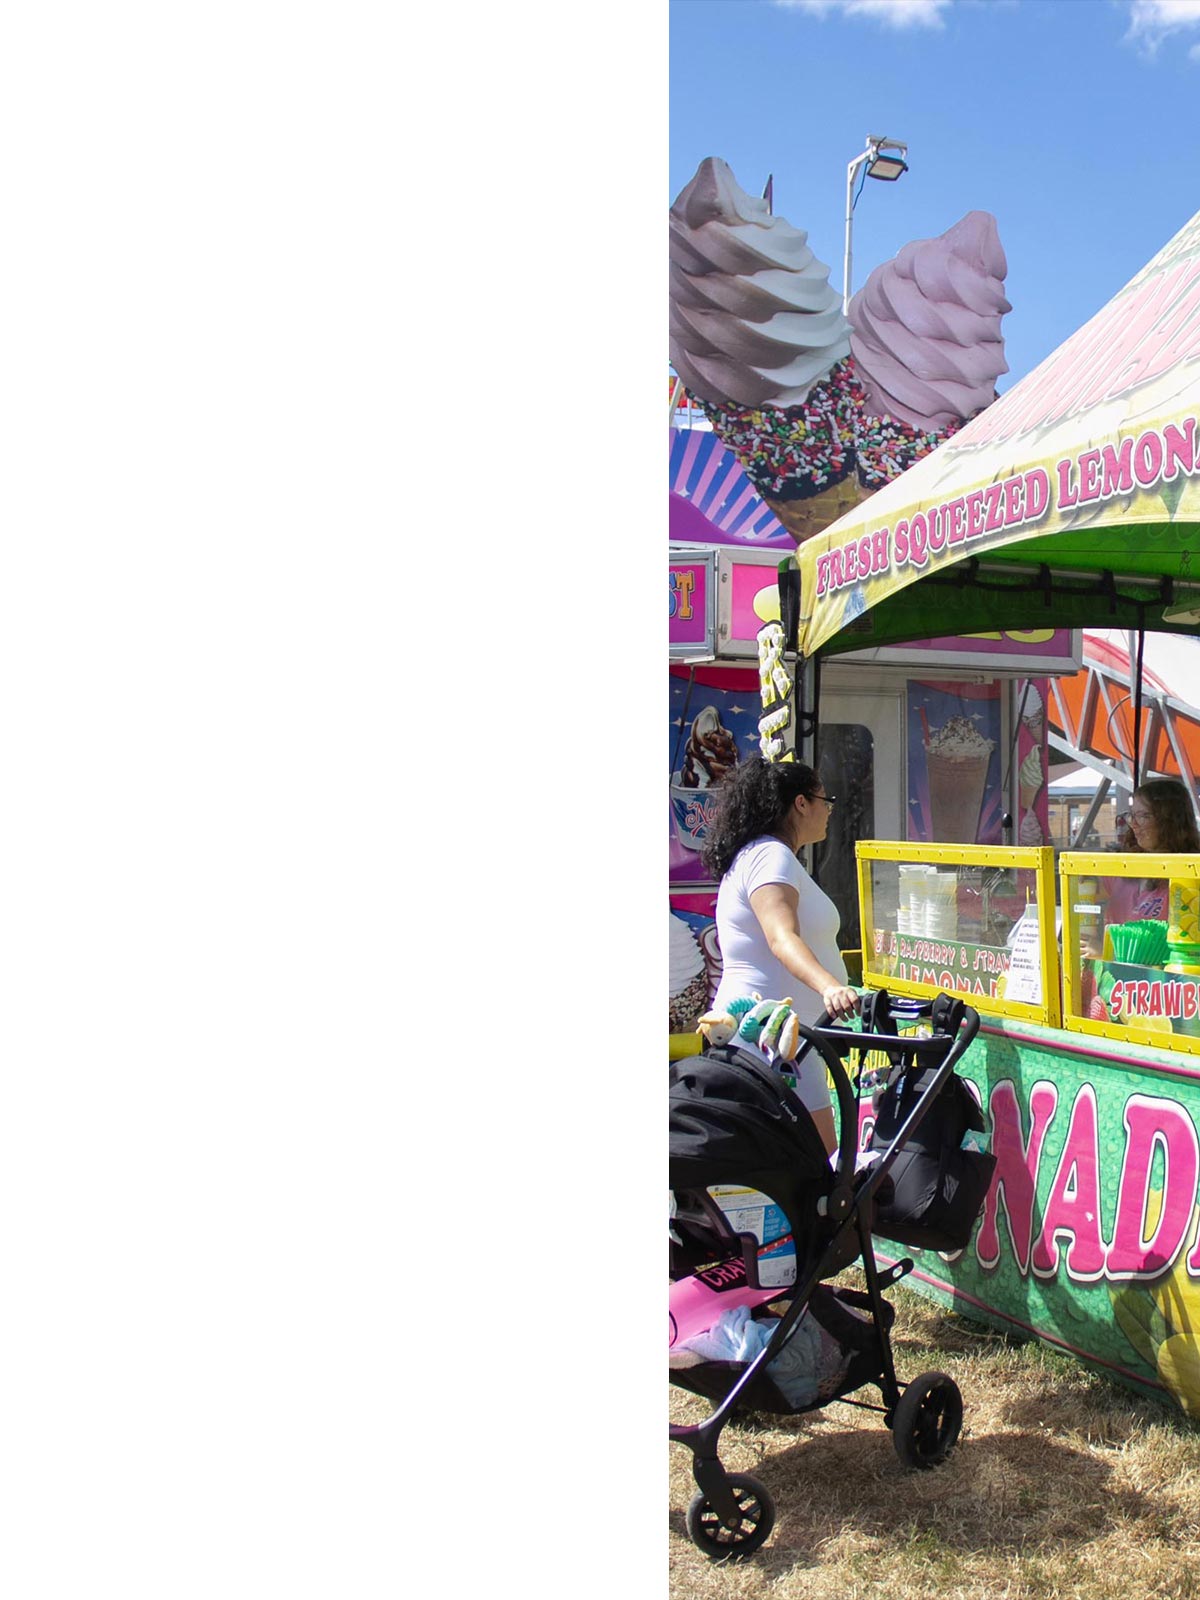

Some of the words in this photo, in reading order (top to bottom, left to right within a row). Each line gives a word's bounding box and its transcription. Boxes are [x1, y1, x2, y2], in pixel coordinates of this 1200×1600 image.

[815, 526, 889, 595] FRESH
[893, 466, 1050, 567] SQUEEZED
[900, 937, 956, 967] RASPBERRY
